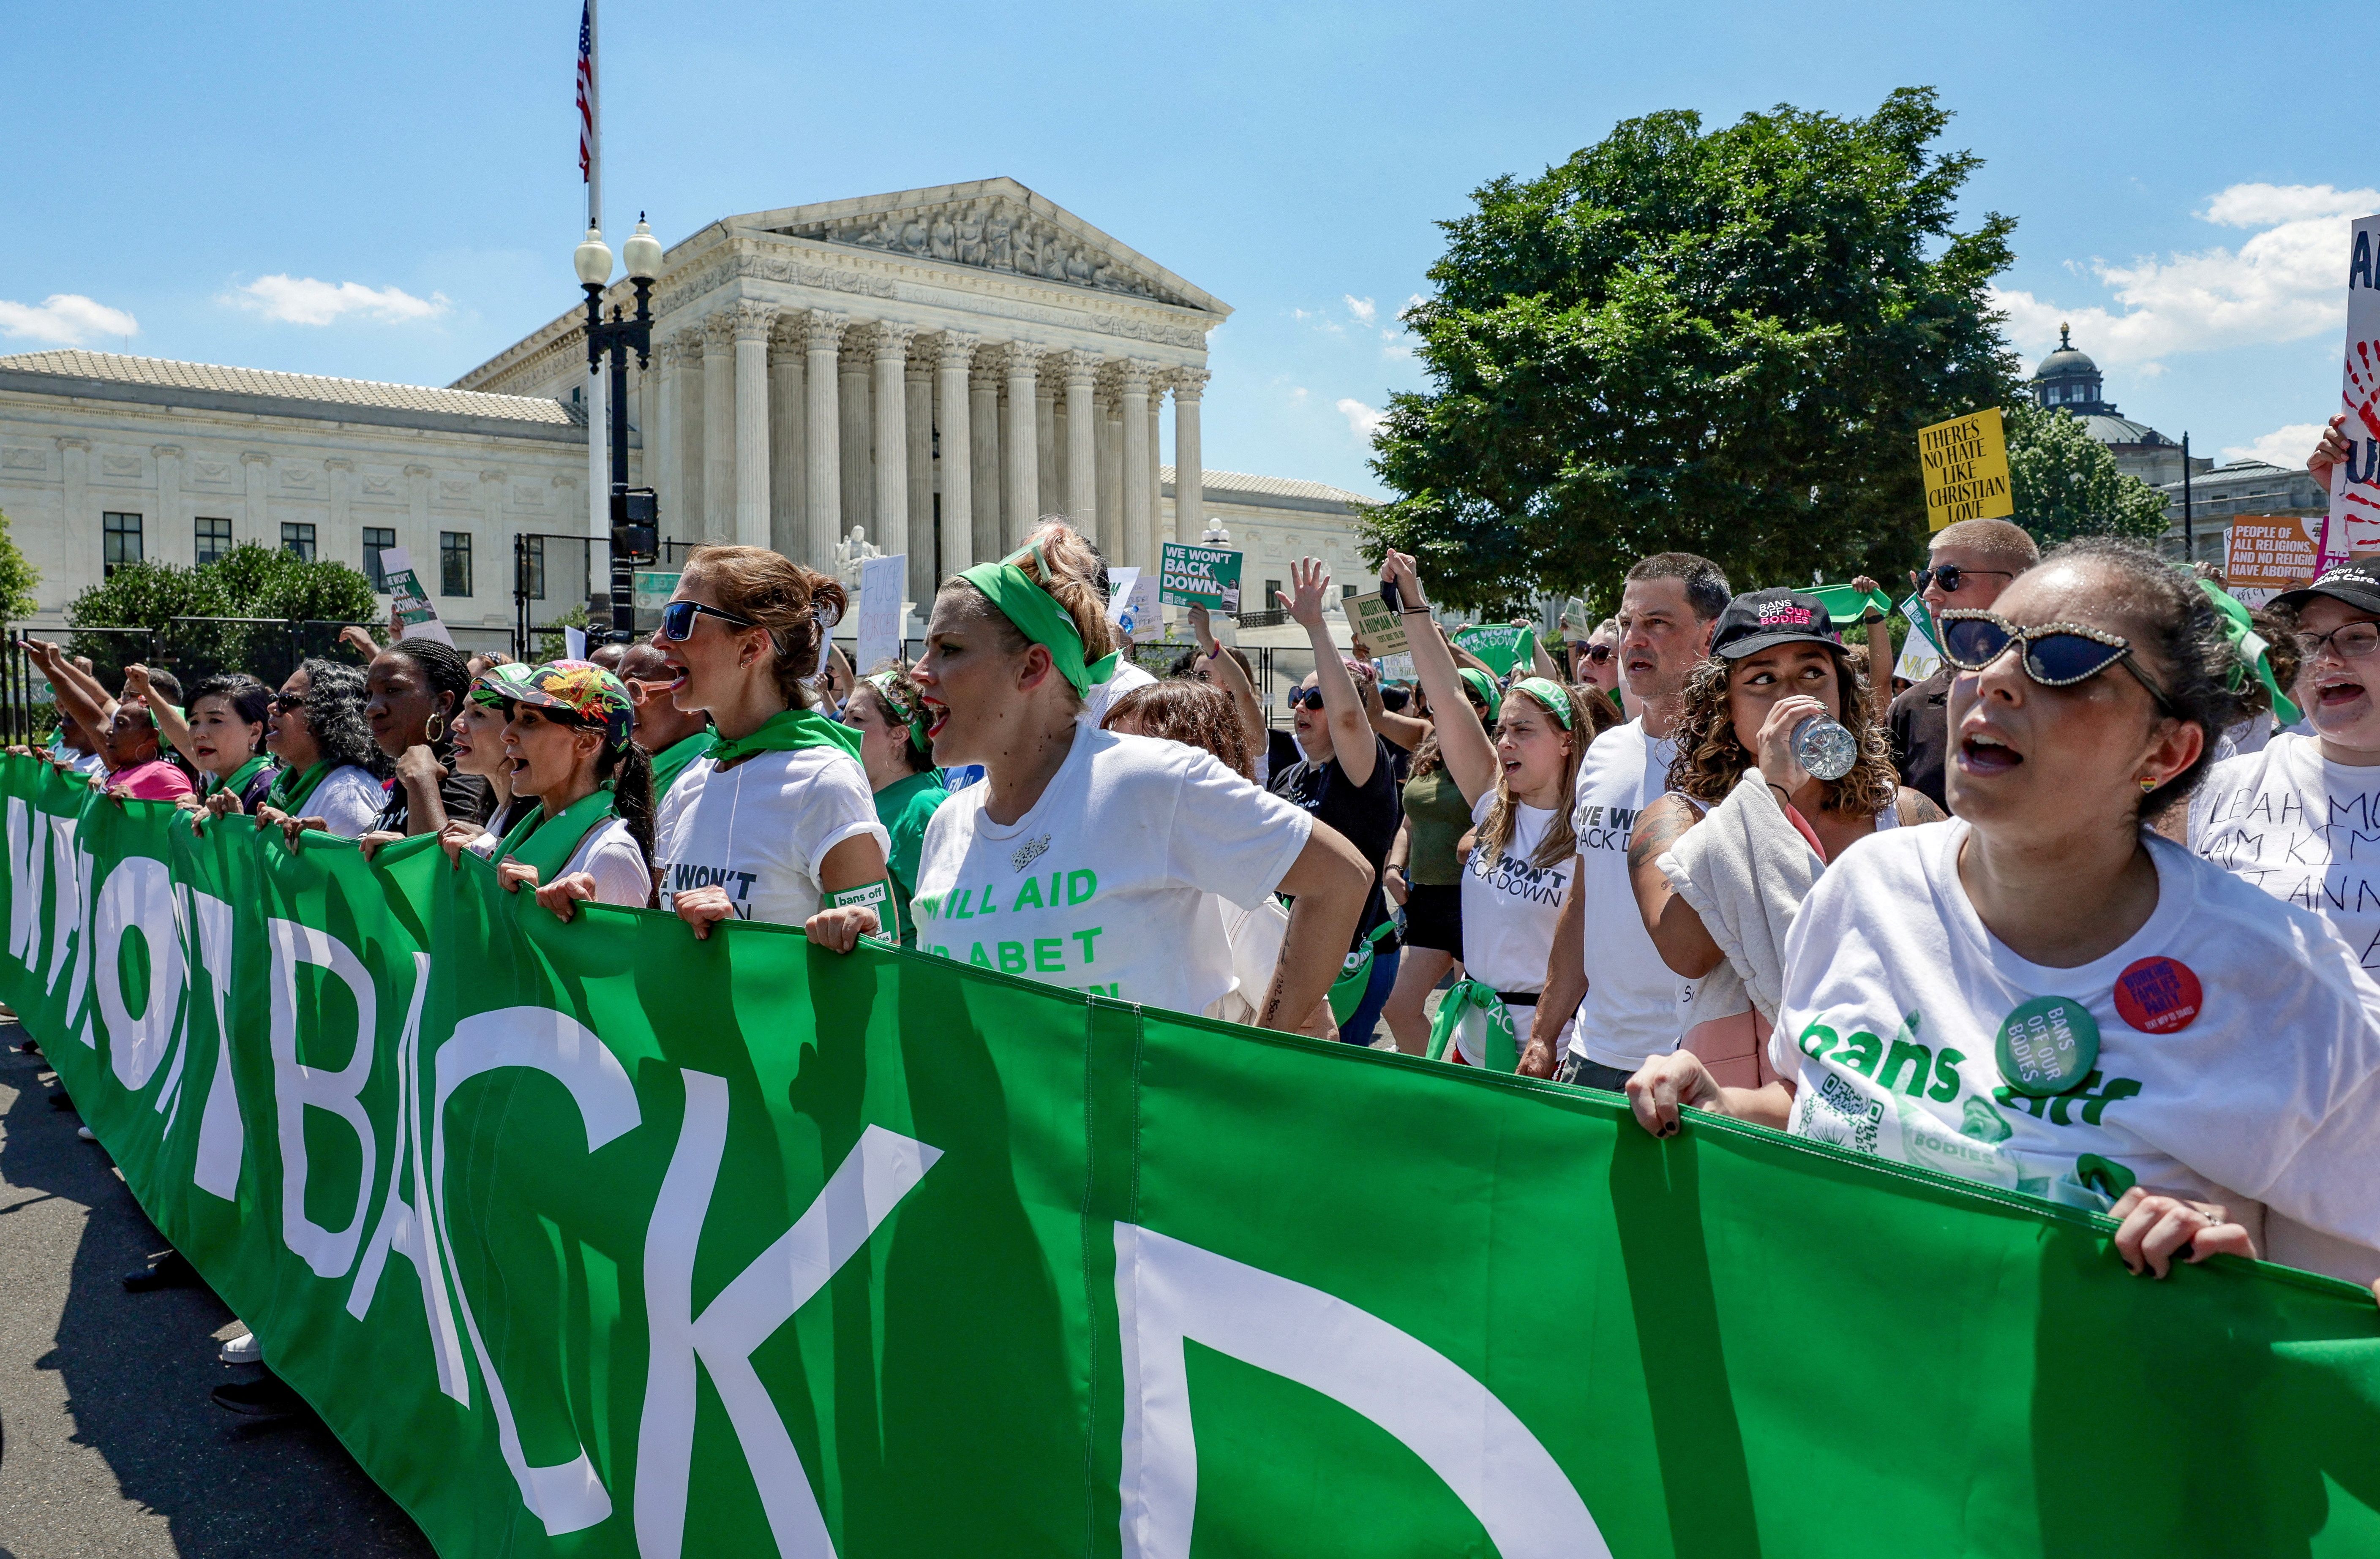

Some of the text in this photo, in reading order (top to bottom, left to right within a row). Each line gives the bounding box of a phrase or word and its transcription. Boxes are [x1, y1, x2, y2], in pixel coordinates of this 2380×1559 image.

[906, 288, 950, 307] EQUAL
[956, 295, 1005, 315] JUSTICE
[1923, 416, 1980, 451] THERE'S
[1923, 438, 1987, 471] NO HATE
[1943, 460, 1977, 485] LIKE
[1929, 476, 2005, 508] CHRISTIAN
[1947, 499, 1984, 523] LOVE
[2235, 525, 2292, 539] PEOPLE OF
[1165, 546, 1232, 564] WE WON'T
[2232, 551, 2255, 563] AND
[2257, 552, 2273, 563] NO
[2275, 553, 2317, 566] RELIGIO
[2233, 539, 2253, 550] ALL
[2255, 539, 2312, 554] RELIGIONS,
[393, 572, 411, 585] WON'T
[1164, 558, 1211, 577] BACK
[2231, 564, 2260, 576] HAVE
[2342, 574, 2379, 585] Care.
[864, 563, 901, 606] FUCK
[1163, 574, 1221, 594] DOWN.
[1758, 599, 1792, 612] BANS
[1758, 607, 1813, 618] OFF OUR
[860, 612, 900, 645] FORCED
[1359, 620, 1367, 635] A
[1364, 615, 1393, 634] HUMAN
[1760, 615, 1810, 625] BODIES
[1459, 633, 1479, 648] WE
[1578, 806, 1604, 826] WE
[2210, 788, 2303, 826] LEAH
[1578, 828, 1618, 851] ACK
[1014, 843, 1050, 873] BODIES
[1497, 850, 1567, 889] WON'T
[676, 863, 757, 900] WON'T
[1012, 868, 1098, 912] AID
[1497, 872, 1562, 908] DOWN
[838, 887, 882, 906] bans off
[970, 926, 1102, 974] ABET
[2047, 1006, 2075, 1051] BANS
[1799, 1012, 1968, 1103] bans
[2008, 1023, 2039, 1082] BODIES
[2027, 1015, 2061, 1081] OFF OUR
[1913, 1132, 1996, 1167] BODIES
[267, 917, 944, 1559] BACK
